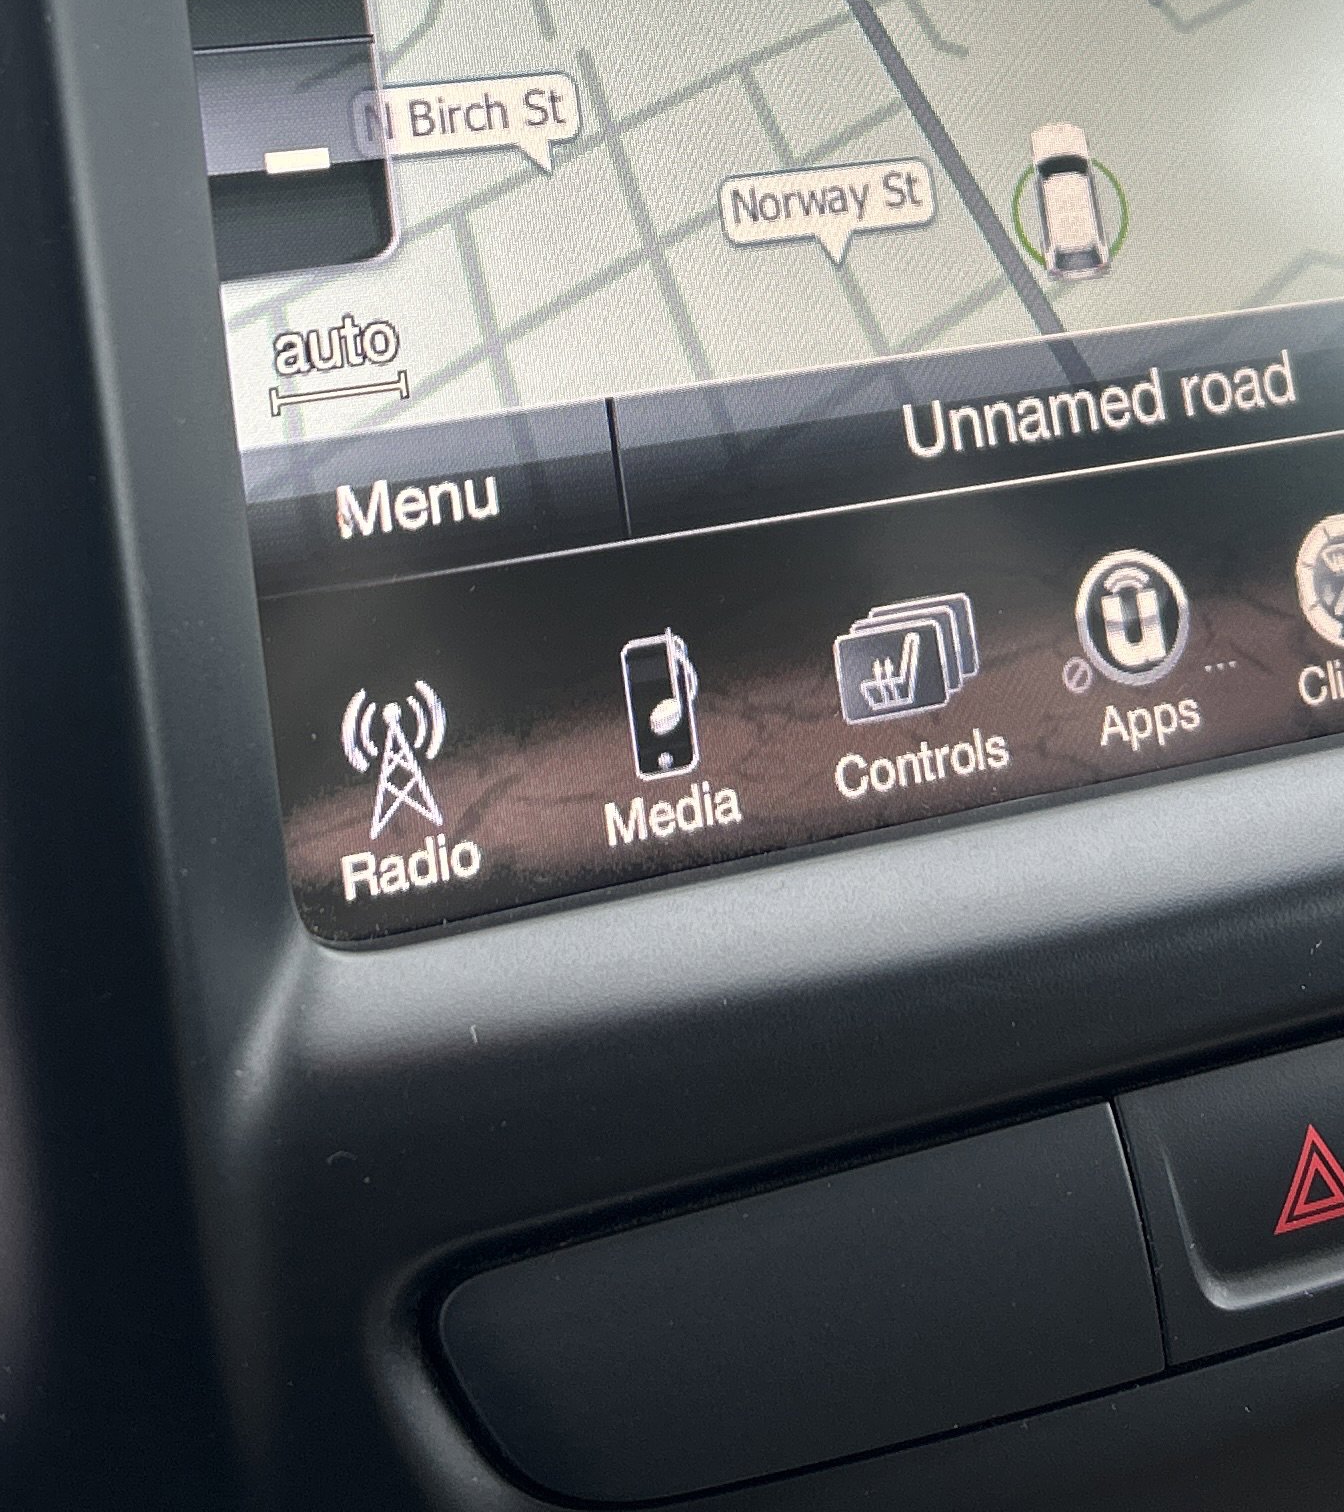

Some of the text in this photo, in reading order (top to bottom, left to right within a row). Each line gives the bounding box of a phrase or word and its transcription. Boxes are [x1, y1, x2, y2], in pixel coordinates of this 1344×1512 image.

[363, 89, 568, 143] N Birch St
[731, 173, 924, 231] Norway St
[272, 313, 401, 377] auto
[902, 349, 1299, 460] Unnamed road
[336, 476, 502, 541] Menu
[1099, 695, 1202, 753] Apps
[834, 728, 1012, 800] Controls
[605, 784, 744, 848] Media
[340, 837, 483, 902] Radio
